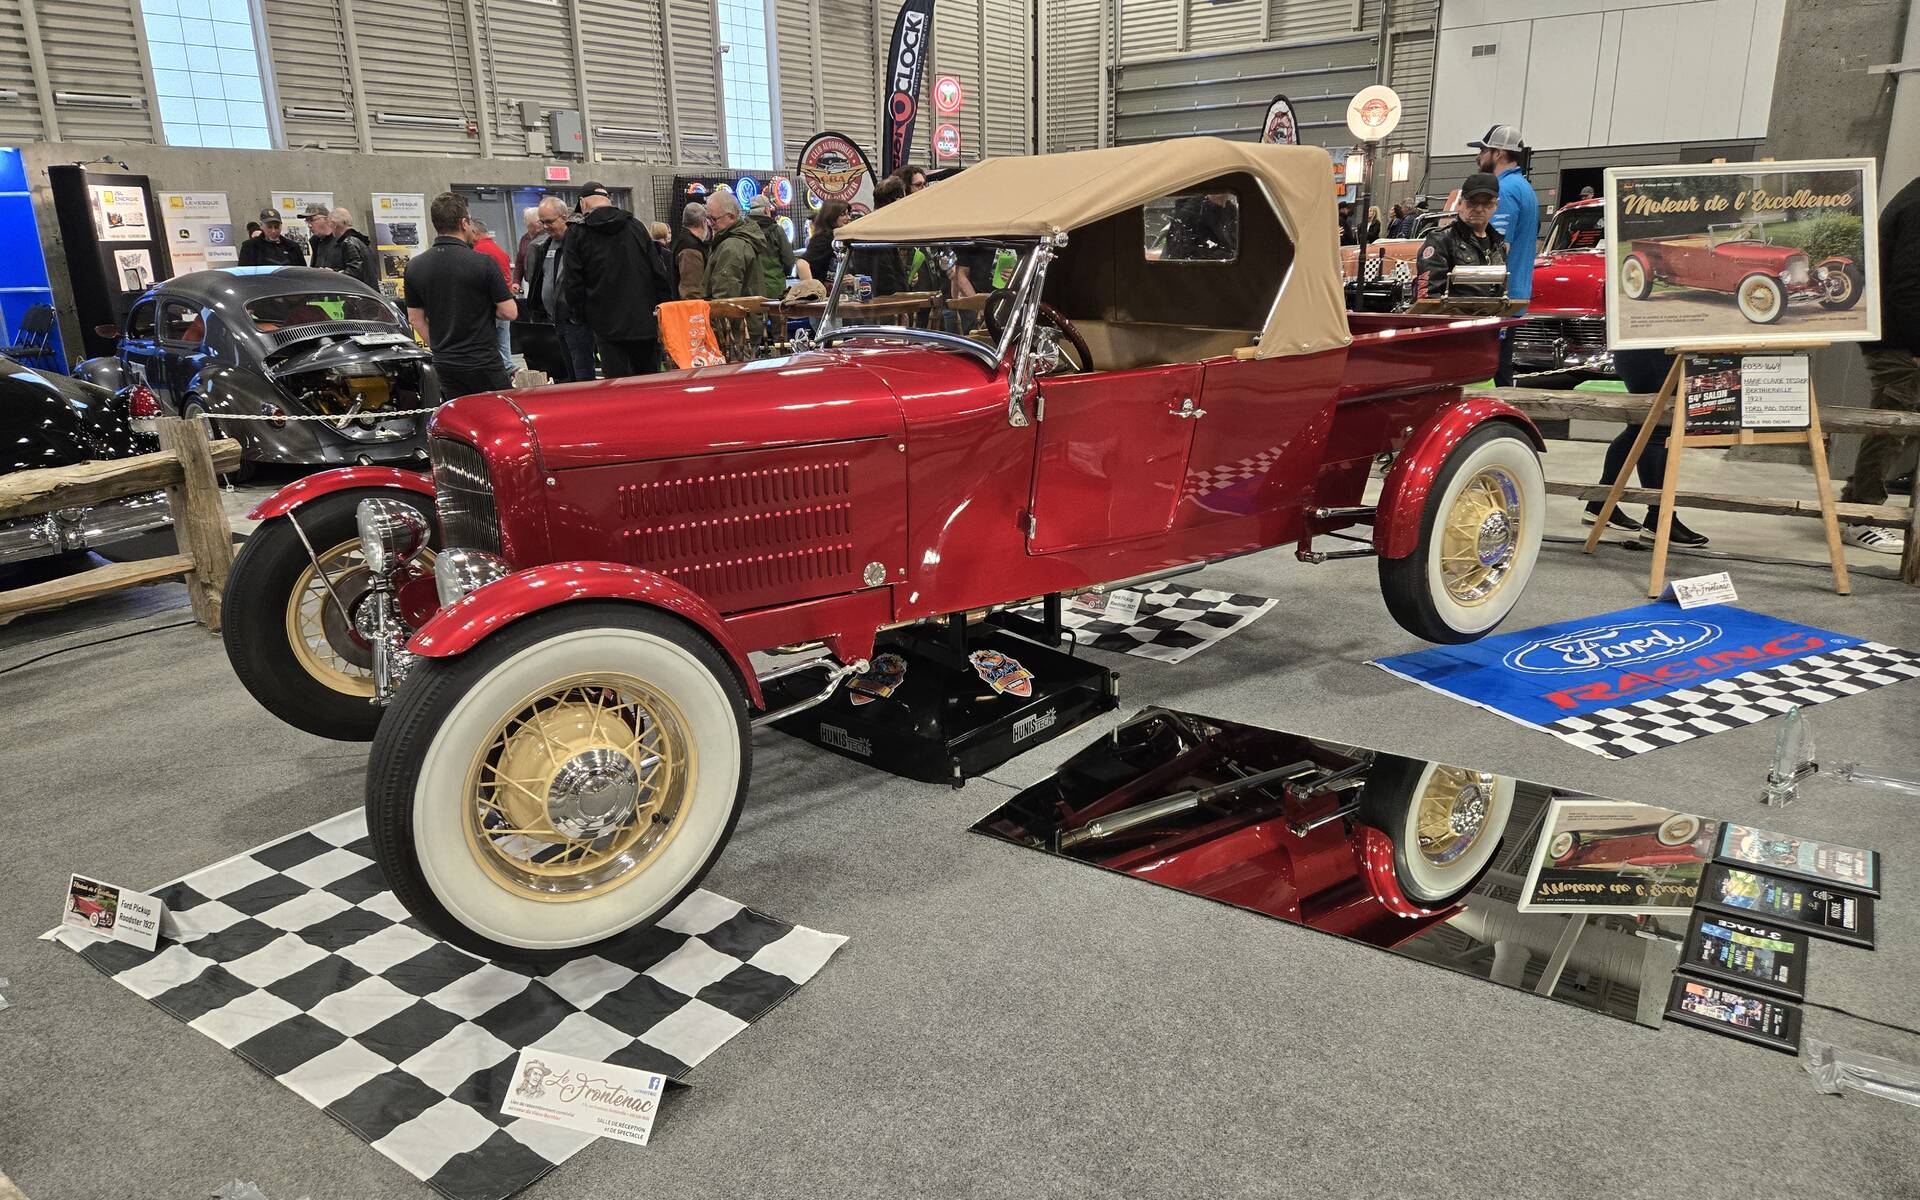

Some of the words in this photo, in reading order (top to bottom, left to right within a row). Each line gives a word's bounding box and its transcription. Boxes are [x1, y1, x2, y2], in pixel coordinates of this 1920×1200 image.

[811, 145, 823, 159] CLUB
[822, 140, 854, 158] AUTOMOBILES
[1623, 193, 1700, 216] Moteur
[1703, 197, 1729, 212] de
[1703, 389, 1728, 401] SALON
[1550, 628, 1688, 665] Ford
[1546, 633, 1826, 709] RACING
[121, 900, 132, 909] Ford
[133, 903, 152, 916] Pickup
[119, 912, 143, 926] Roadster
[143, 919, 156, 930] 1927
[1718, 919, 1766, 936] PLACE
[545, 1069, 571, 1087] Le
[559, 1072, 654, 1113] Frontenac
[597, 1116, 611, 1126] SALLE
[611, 1119, 618, 1127] DE
[618, 1120, 646, 1134] RÉCEPTION
[617, 1129, 644, 1140] SPECTACLE
